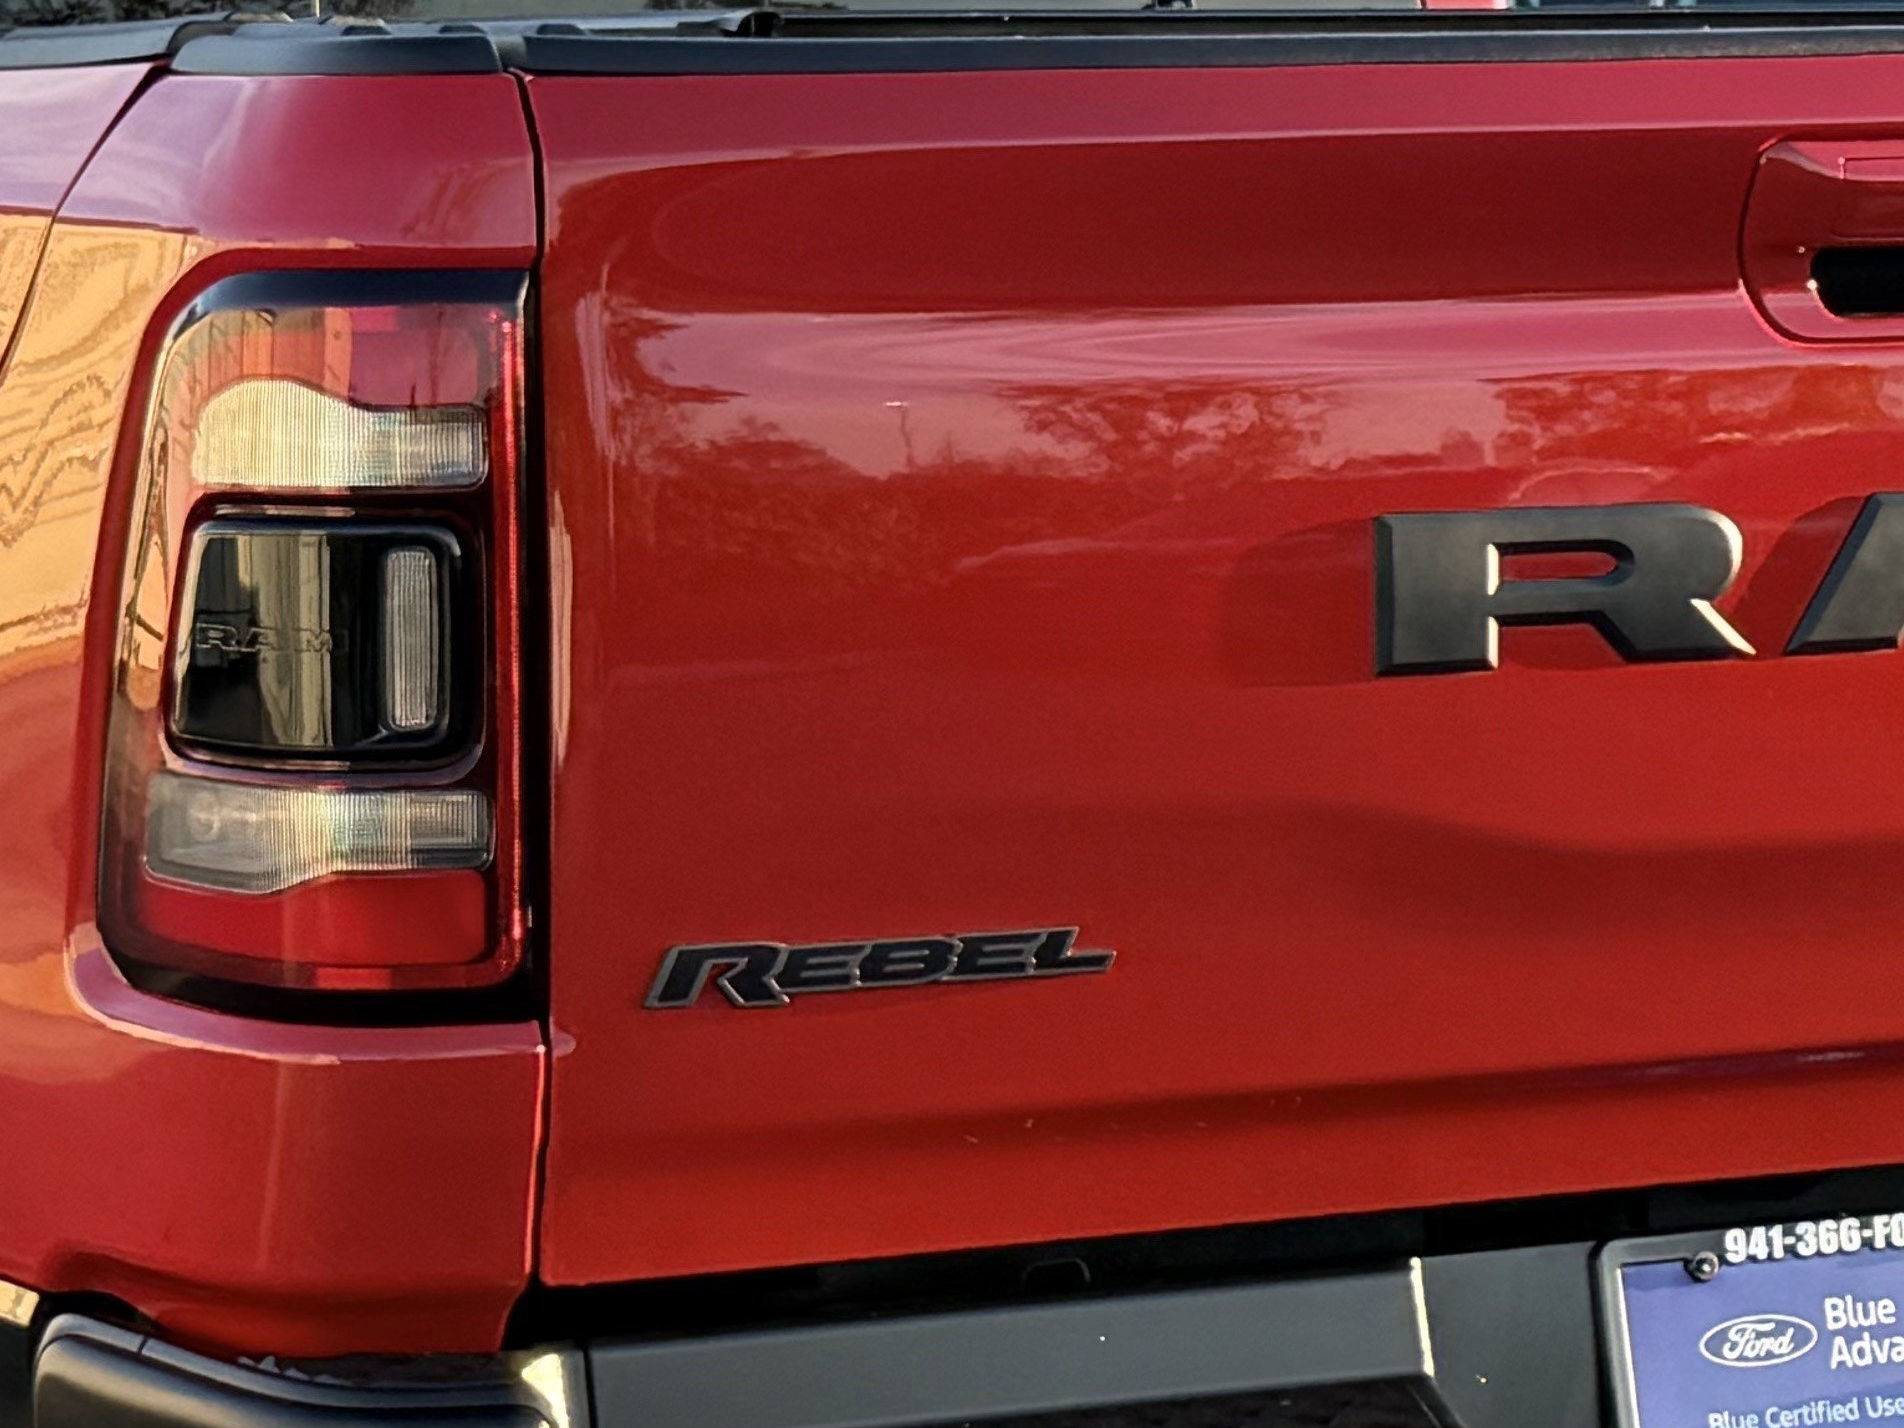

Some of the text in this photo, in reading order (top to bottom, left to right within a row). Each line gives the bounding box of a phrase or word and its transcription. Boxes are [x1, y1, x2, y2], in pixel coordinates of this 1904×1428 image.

[642, 926, 1118, 1009] REBEL
[1823, 1295, 1897, 1328] Blue
[1722, 1320, 1796, 1362] Ford
